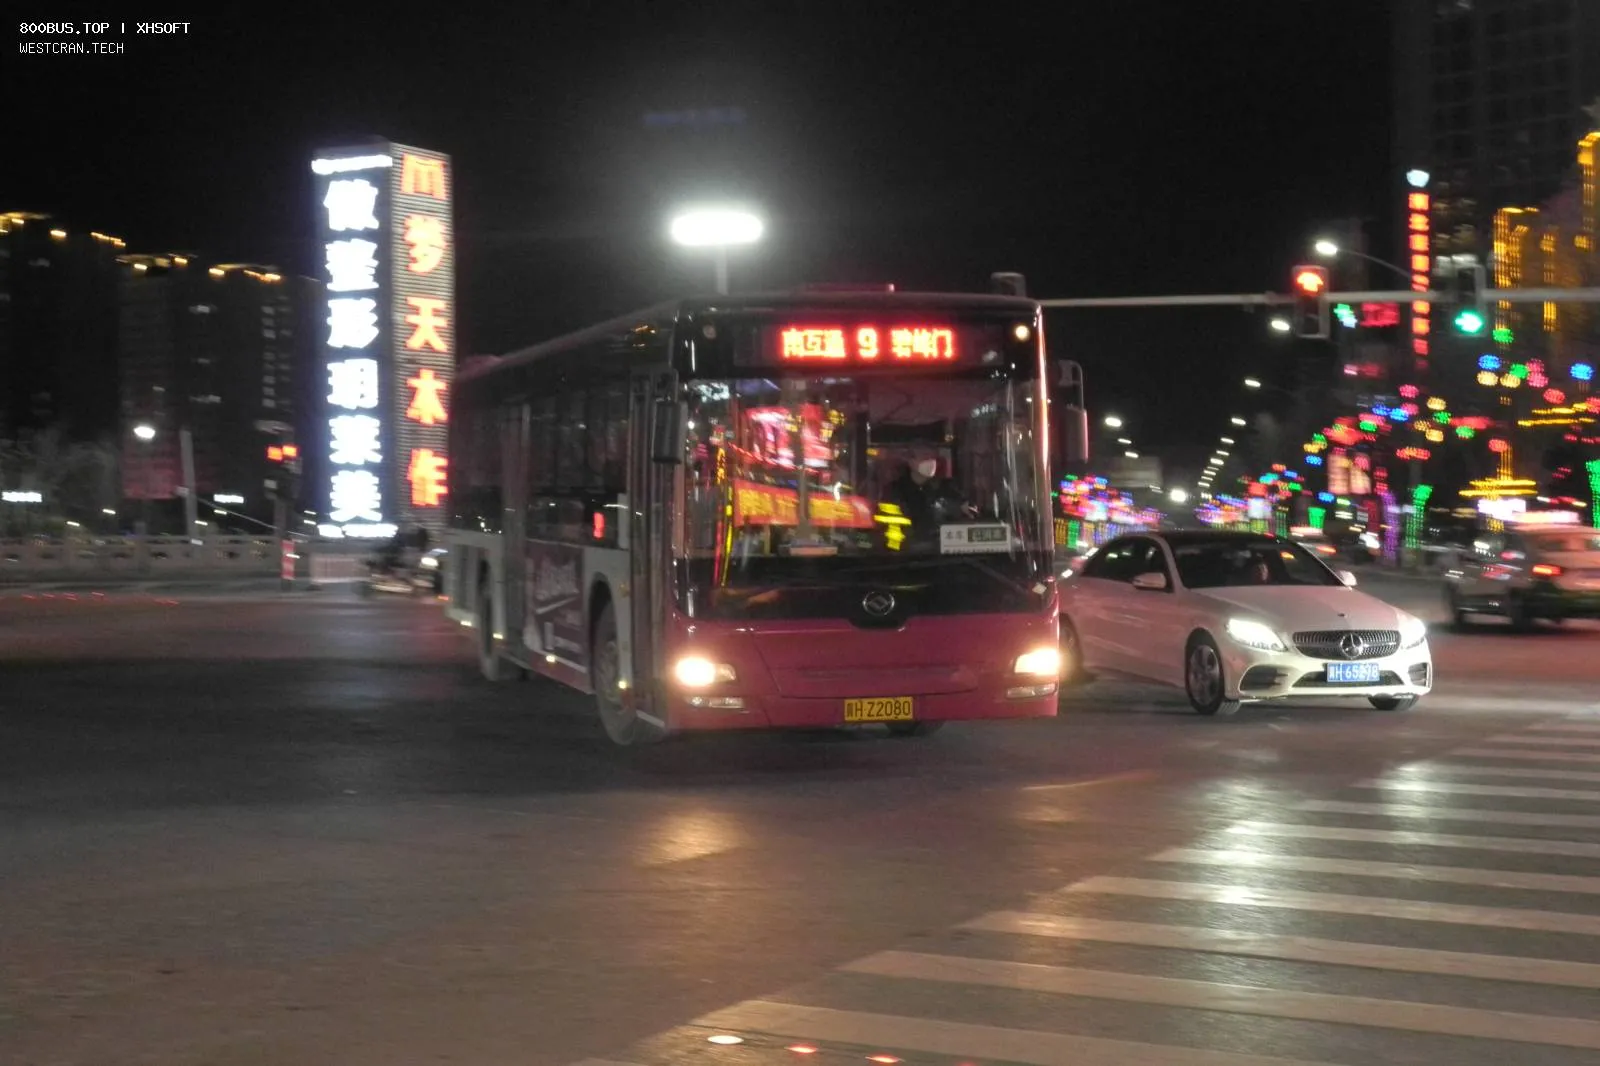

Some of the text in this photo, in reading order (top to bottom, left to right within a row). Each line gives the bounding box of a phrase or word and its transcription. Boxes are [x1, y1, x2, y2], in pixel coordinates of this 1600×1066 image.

[404, 213, 449, 506] 梦天木作
[857, 327, 880, 358] 9
